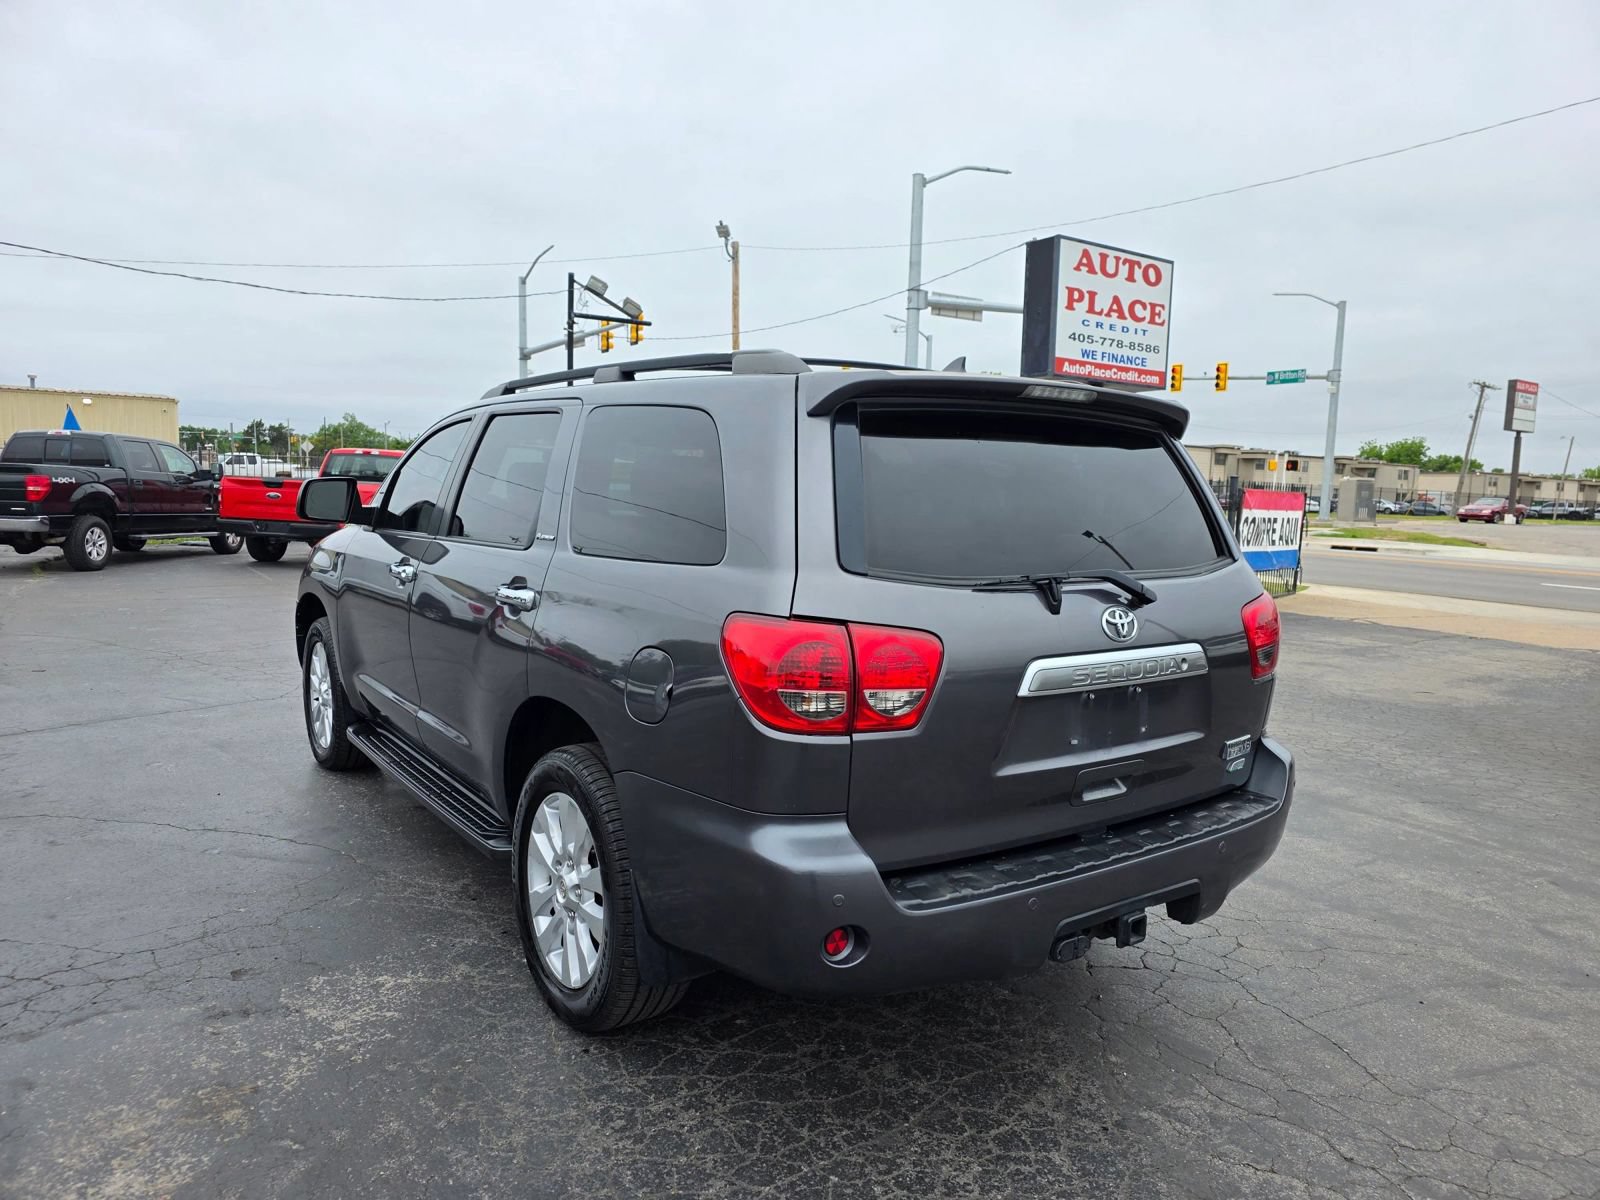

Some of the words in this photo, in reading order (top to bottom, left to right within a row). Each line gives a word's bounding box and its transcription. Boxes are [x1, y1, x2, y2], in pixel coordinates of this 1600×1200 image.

[1073, 248, 1162, 287] AUTO
[1064, 286, 1166, 327] PLACE
[1081, 319, 1149, 336] CREDIT
[1068, 332, 1161, 354] 405-778-8586
[1080, 348, 1097, 360] WE
[1101, 352, 1147, 367] FINANCE
[1062, 361, 1159, 384] AutoPlaceCredit.com
[1278, 516, 1299, 546] AQUI
[1071, 657, 1181, 686] SEQUOIA
